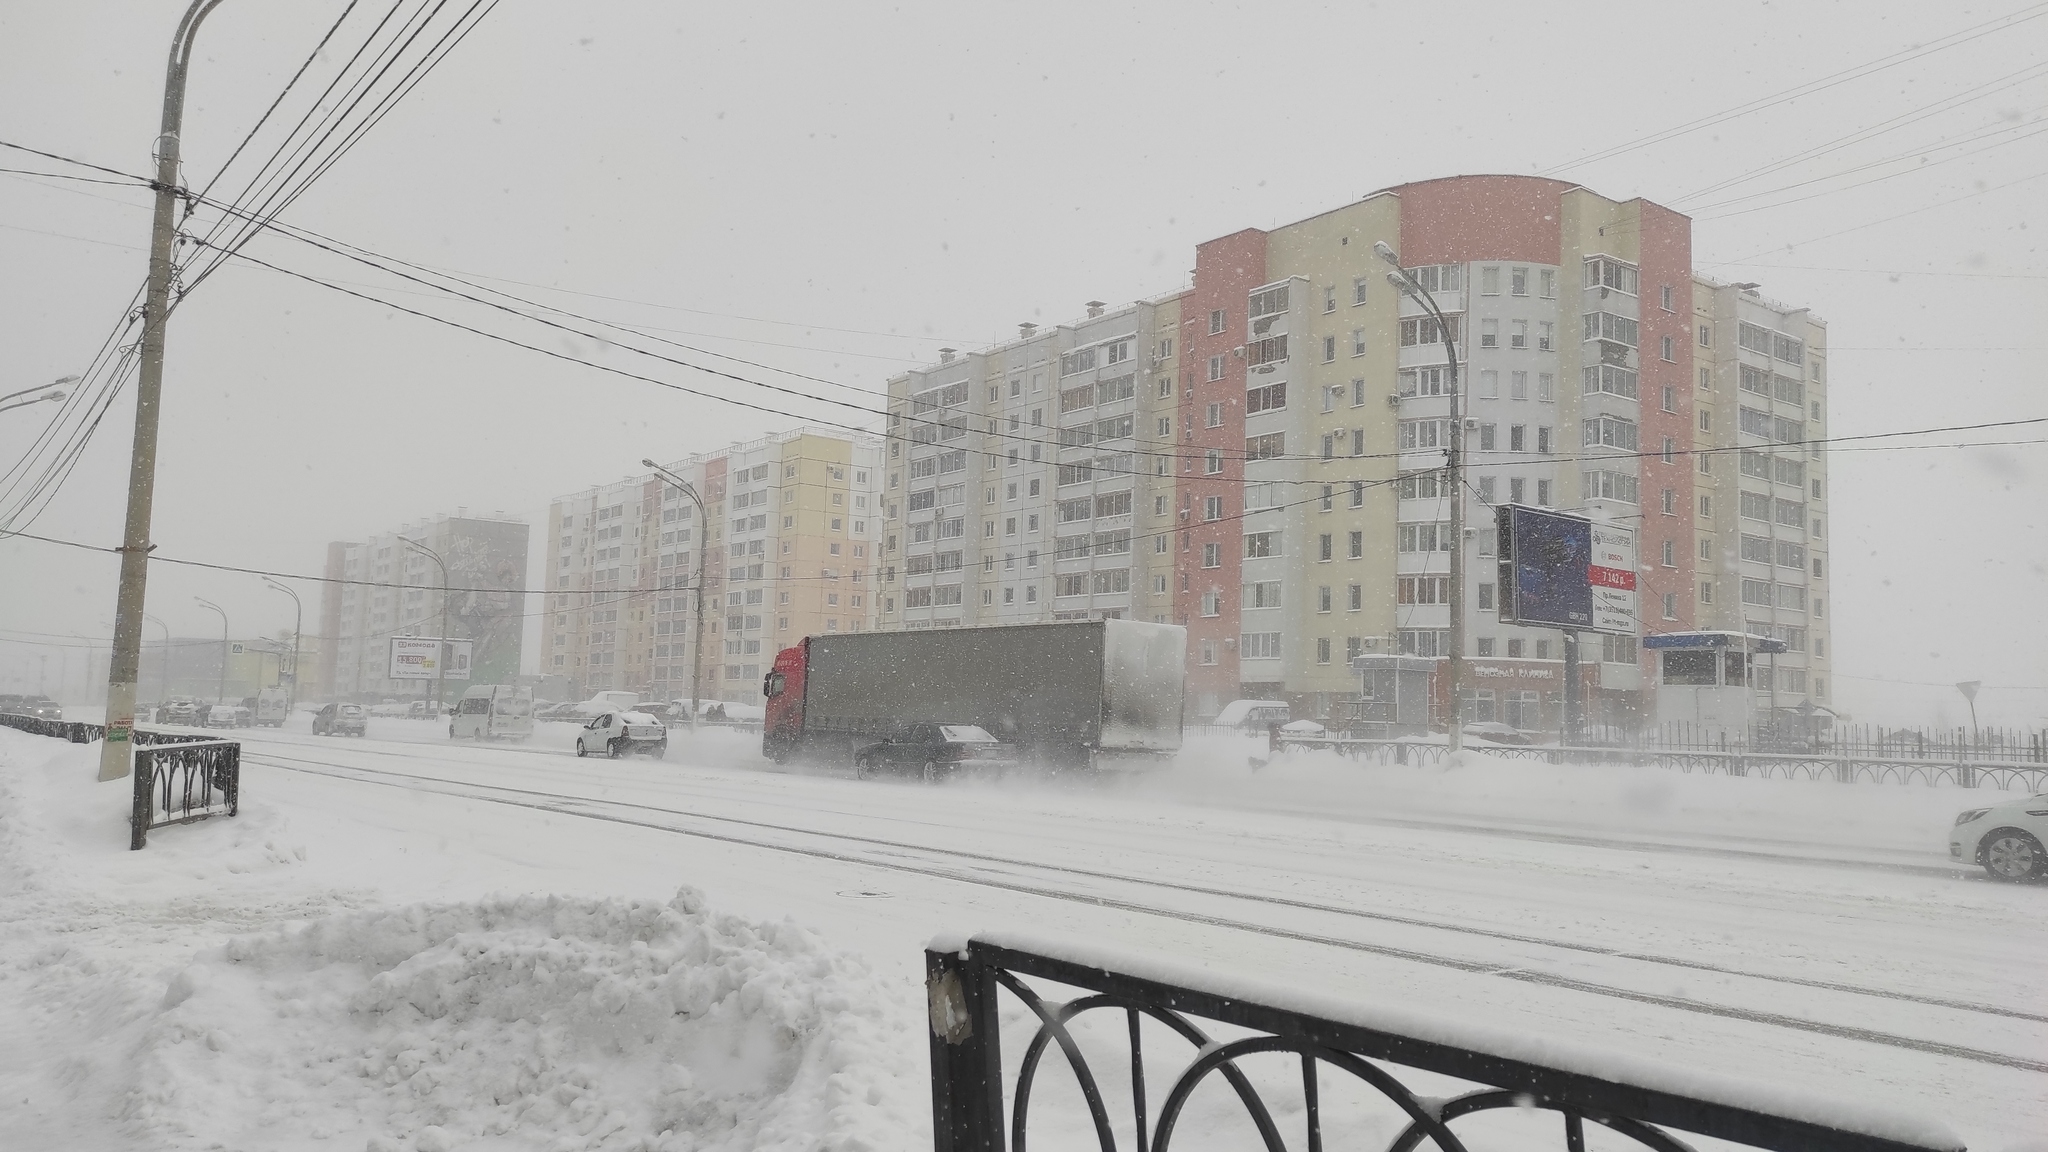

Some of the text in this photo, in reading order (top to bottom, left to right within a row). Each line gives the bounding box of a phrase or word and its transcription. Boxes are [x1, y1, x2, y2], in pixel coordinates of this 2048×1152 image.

[1608, 554, 1623, 562] BOSCH
[1602, 572, 1606, 582] 7
[1518, 668, 1554, 679] КЛИНИКА
